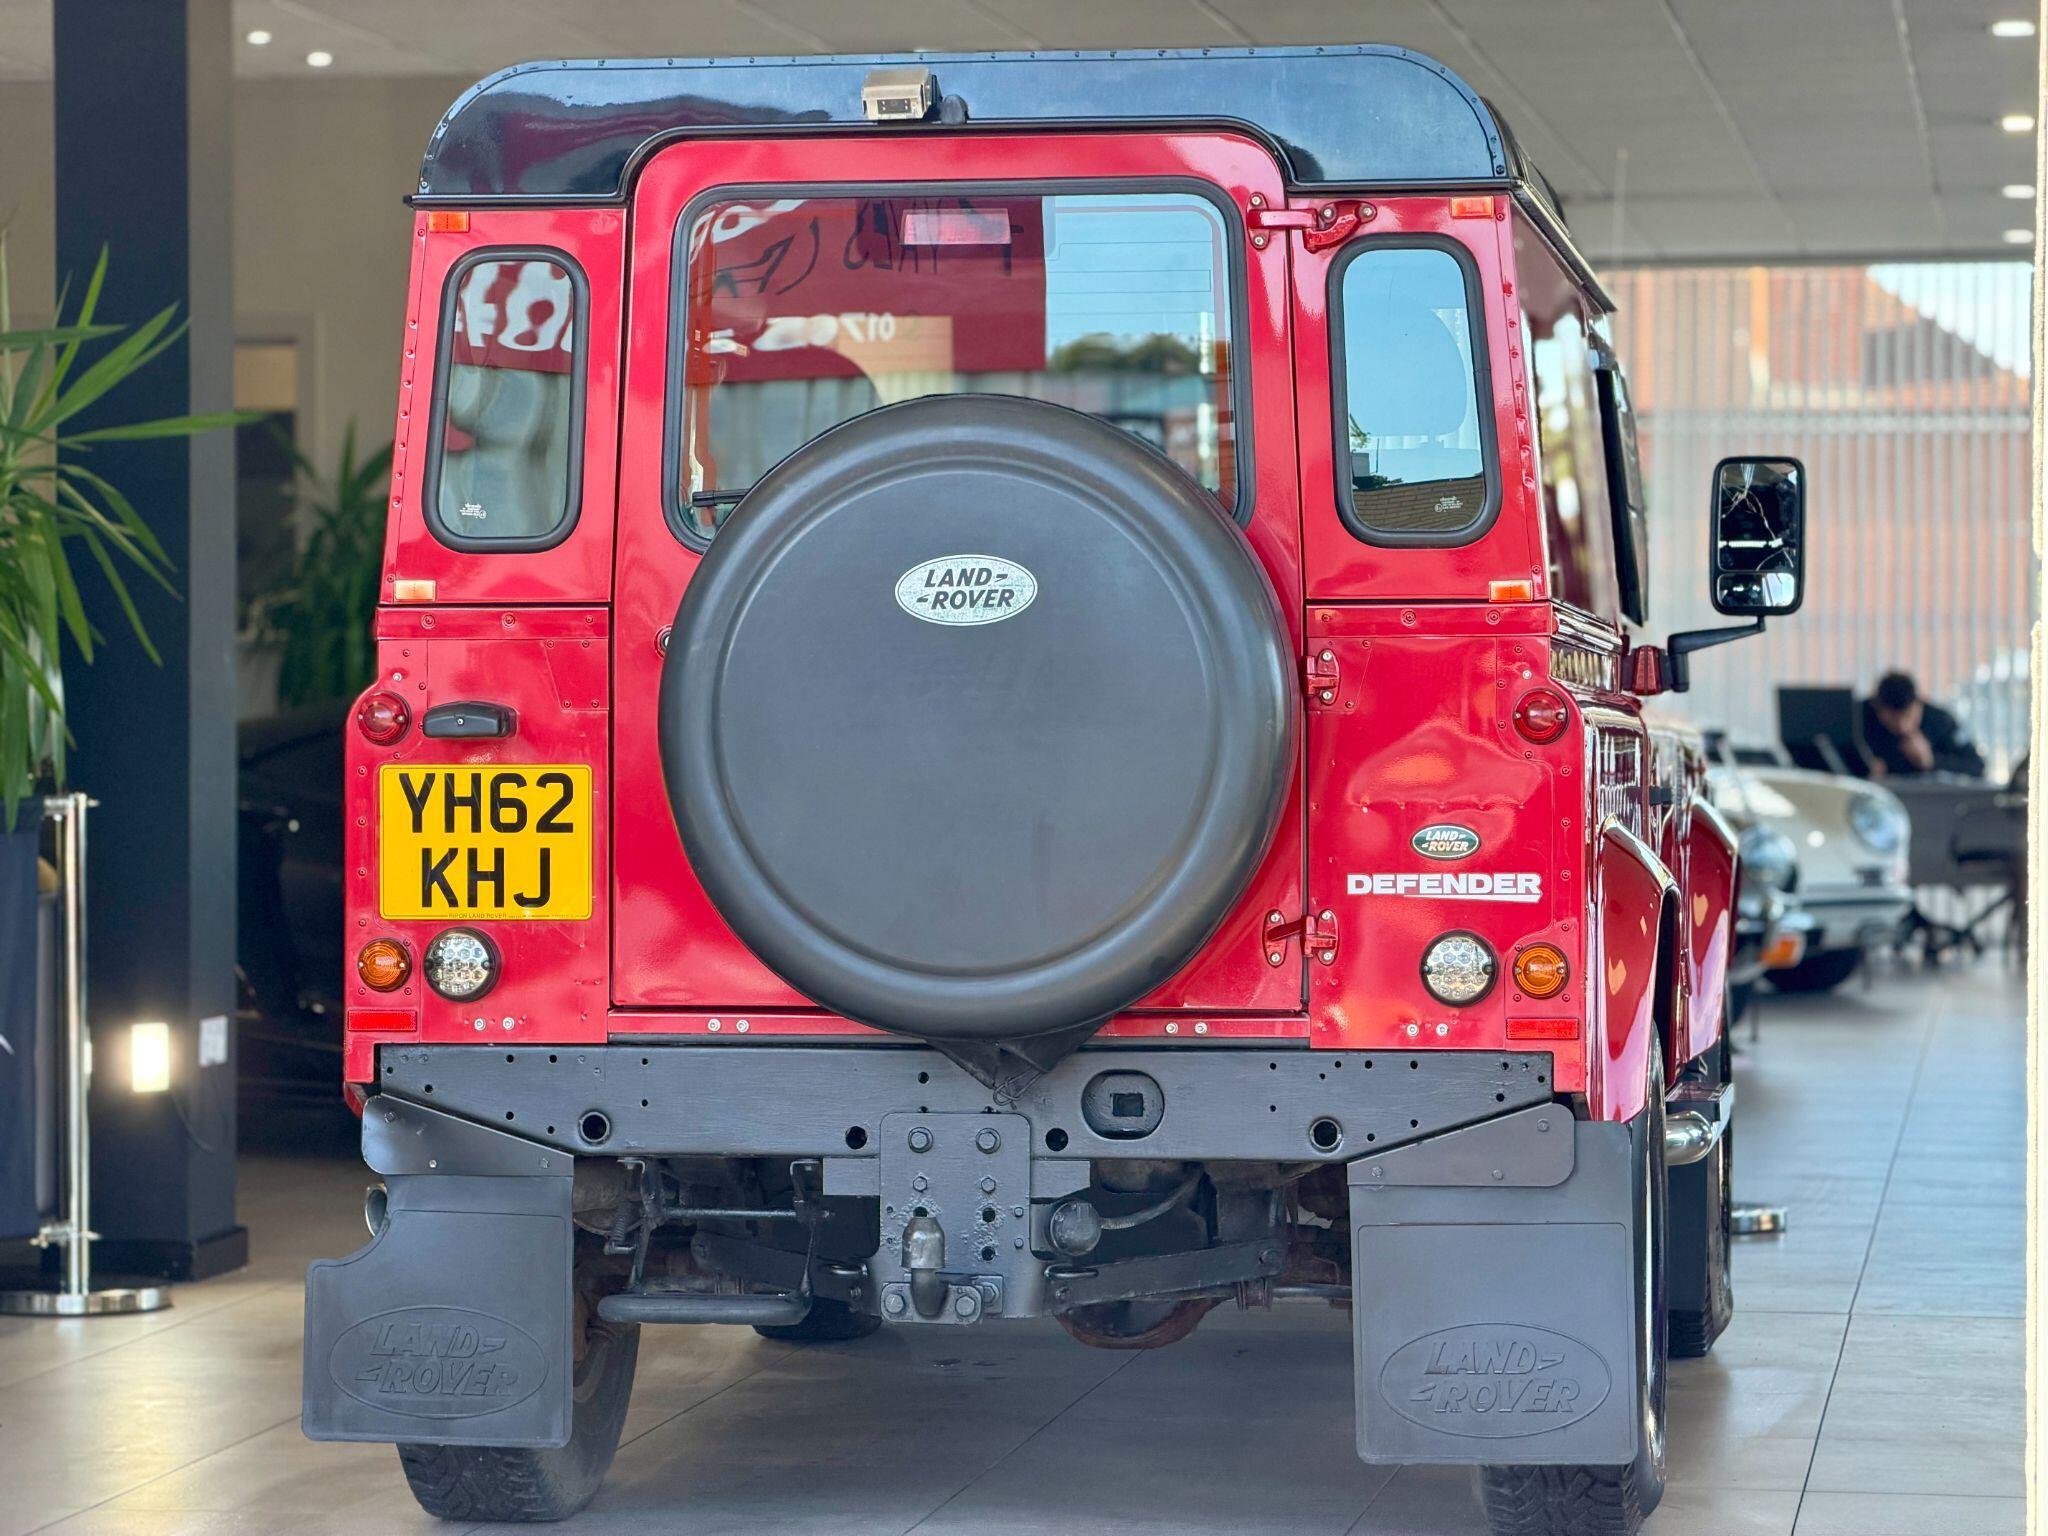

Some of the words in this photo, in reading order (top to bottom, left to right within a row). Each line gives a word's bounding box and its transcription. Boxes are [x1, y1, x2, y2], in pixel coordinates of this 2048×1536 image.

[924, 567, 993, 588] LAND
[931, 588, 1015, 610] ROVER
[398, 772, 575, 834] YH62
[1425, 830, 1459, 841] LAND
[1428, 840, 1469, 852] ROVER
[421, 847, 551, 909] KHJ
[1347, 873, 1543, 897] DEFENDER
[369, 1322, 480, 1359] LAND
[1423, 1340, 1538, 1375] LAND
[378, 1359, 519, 1396] ROVER
[1433, 1378, 1581, 1413] ROVER
